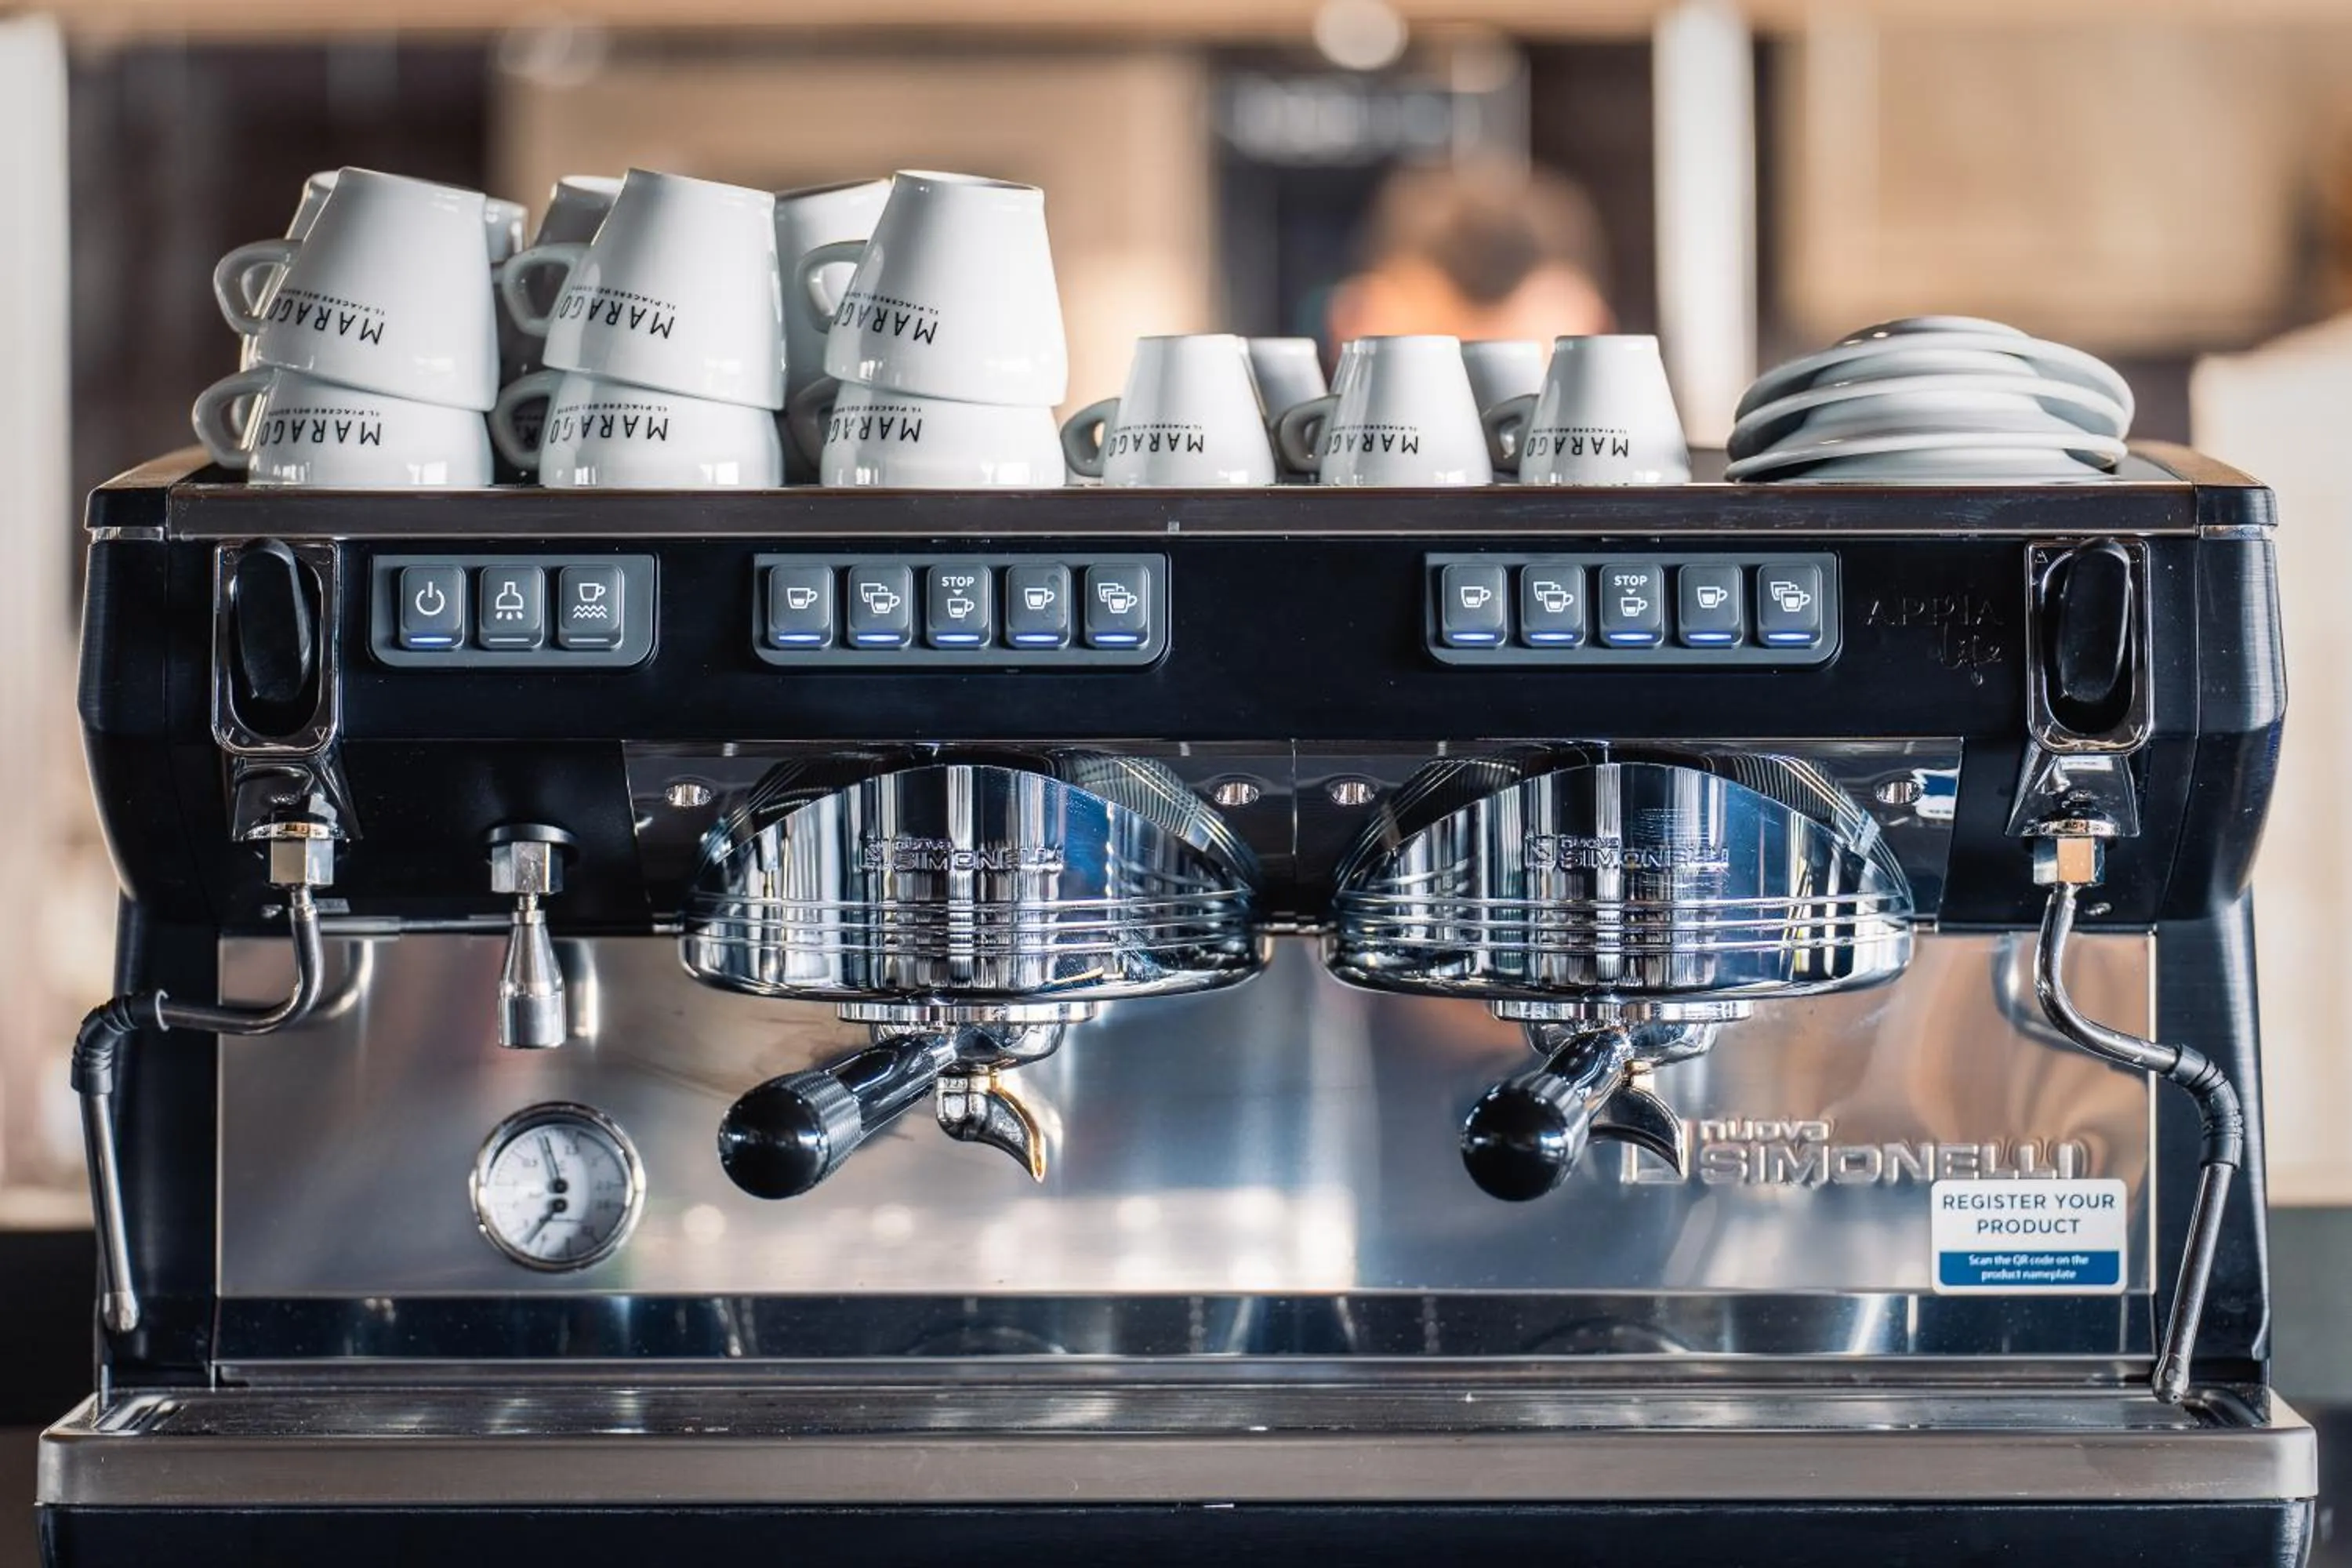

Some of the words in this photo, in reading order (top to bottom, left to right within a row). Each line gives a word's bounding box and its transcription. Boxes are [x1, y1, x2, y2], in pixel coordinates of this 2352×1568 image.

[559, 296, 674, 339] MARAGO
[260, 419, 381, 446] MARAGO
[550, 415, 668, 444] MARAGO
[1109, 433, 1203, 457] MARAGO
[1527, 437, 1628, 458] MARAGO
[942, 576, 975, 587] STOP
[1614, 575, 1647, 586] STOP
[1866, 594, 2004, 626] APPIA
[1700, 1119, 1830, 1141] nuova
[1700, 1142, 2074, 1184] SIMONELLI
[1943, 1194, 2046, 1210] REGISTER
[2055, 1193, 2115, 1209] YOUR
[1977, 1219, 2081, 1234] PRODUCT
[1969, 1254, 1992, 1265] Scan
[1994, 1254, 2011, 1265] the
[2013, 1254, 2028, 1266] QR
[2030, 1254, 2054, 1265] code
[2072, 1254, 2089, 1265] the
[1981, 1269, 2020, 1282] product
[2023, 1269, 2077, 1283] nameplate
